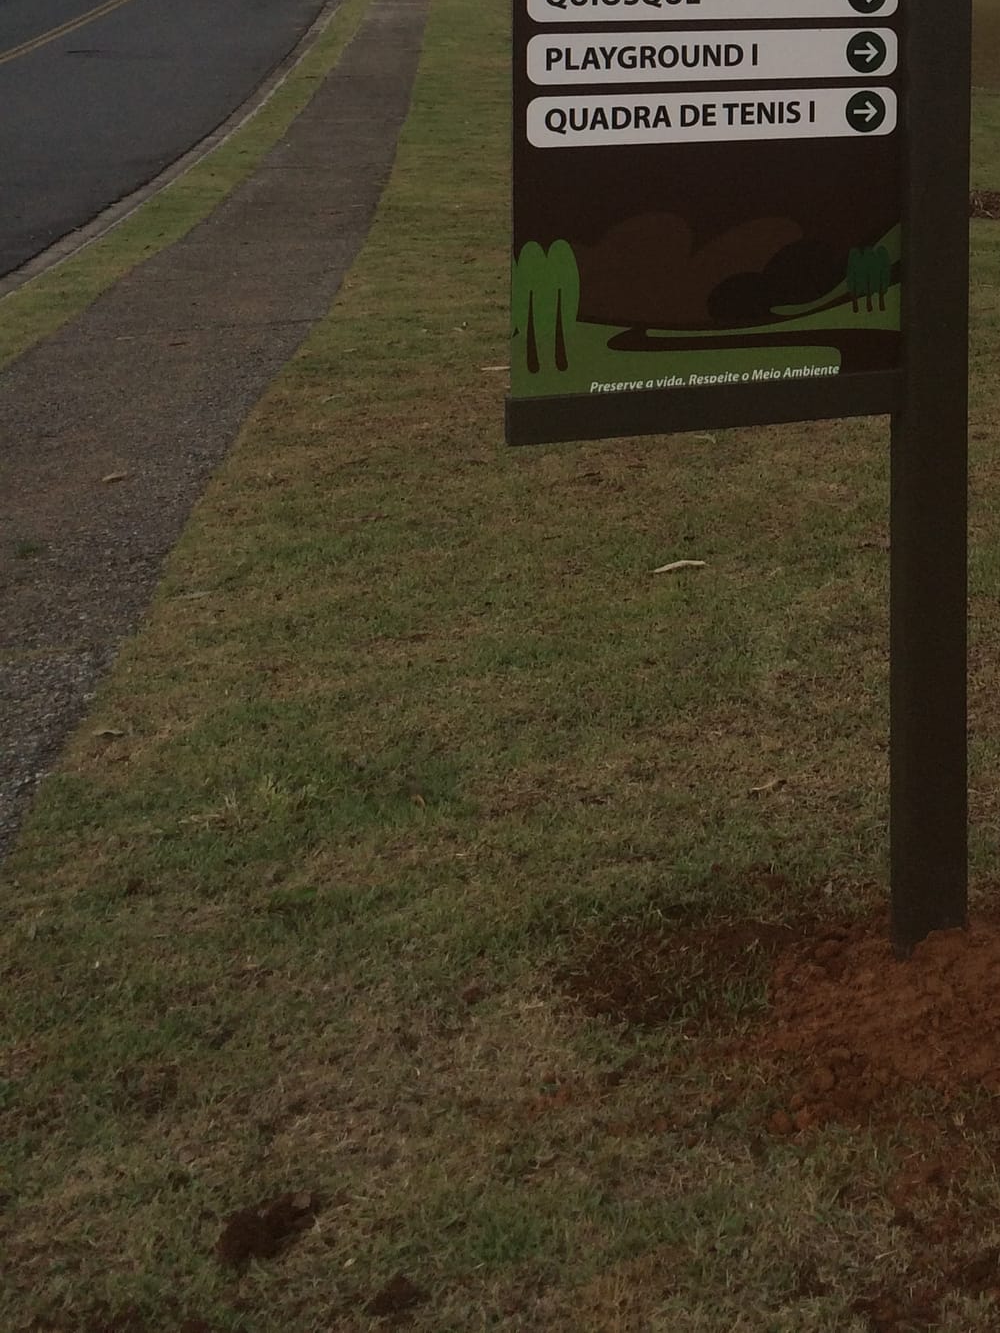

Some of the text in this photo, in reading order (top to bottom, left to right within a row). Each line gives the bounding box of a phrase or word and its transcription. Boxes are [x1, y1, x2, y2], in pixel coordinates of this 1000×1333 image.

[545, 43, 758, 71] PLAYGROUND I
[544, 100, 815, 134] QUADRA DE TENIS I
[590, 365, 839, 393] Preserve a vida. Respeite o Meio Ambiente
